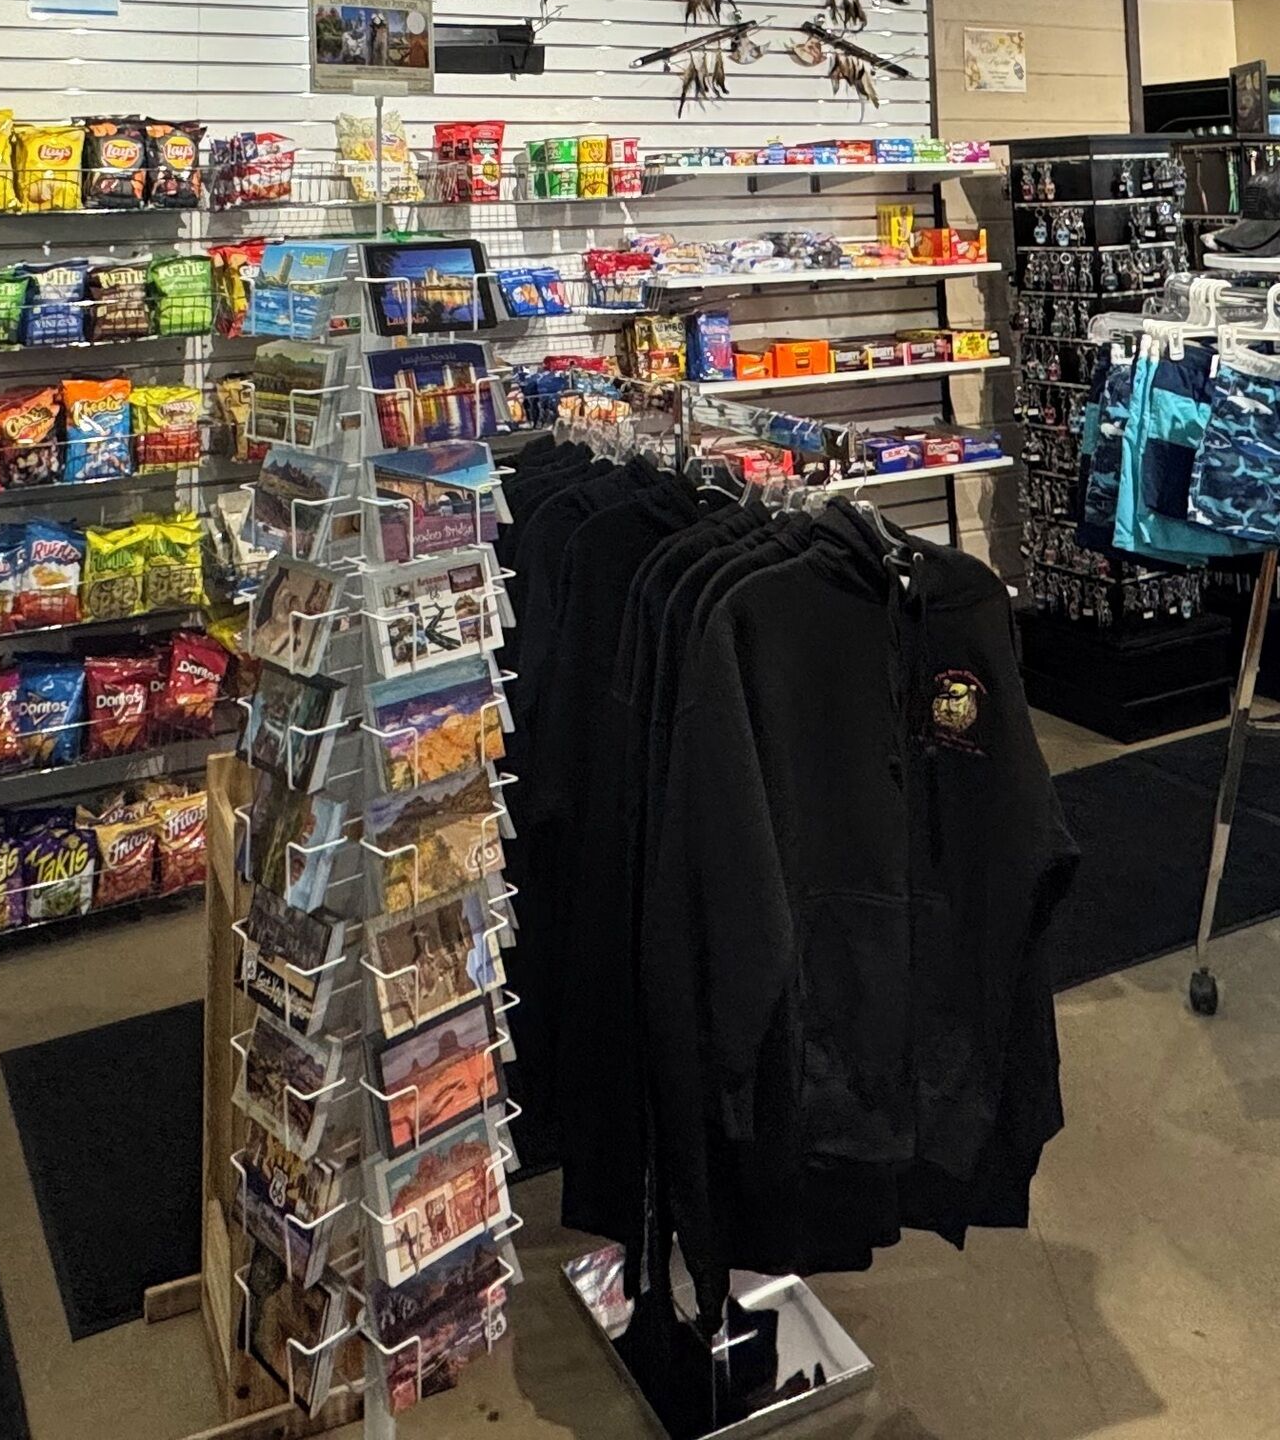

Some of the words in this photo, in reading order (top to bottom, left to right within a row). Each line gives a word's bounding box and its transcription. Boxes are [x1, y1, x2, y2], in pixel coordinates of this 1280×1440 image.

[346, 165, 367, 174] Brim
[369, 165, 401, 176] Ppcorn
[176, 660, 221, 682] Doritos
[19, 701, 68, 717] Doritos
[95, 691, 142, 710] Doritos
[169, 806, 208, 837] Fritos
[109, 830, 150, 864] Fritos
[37, 843, 89, 888] Takis
